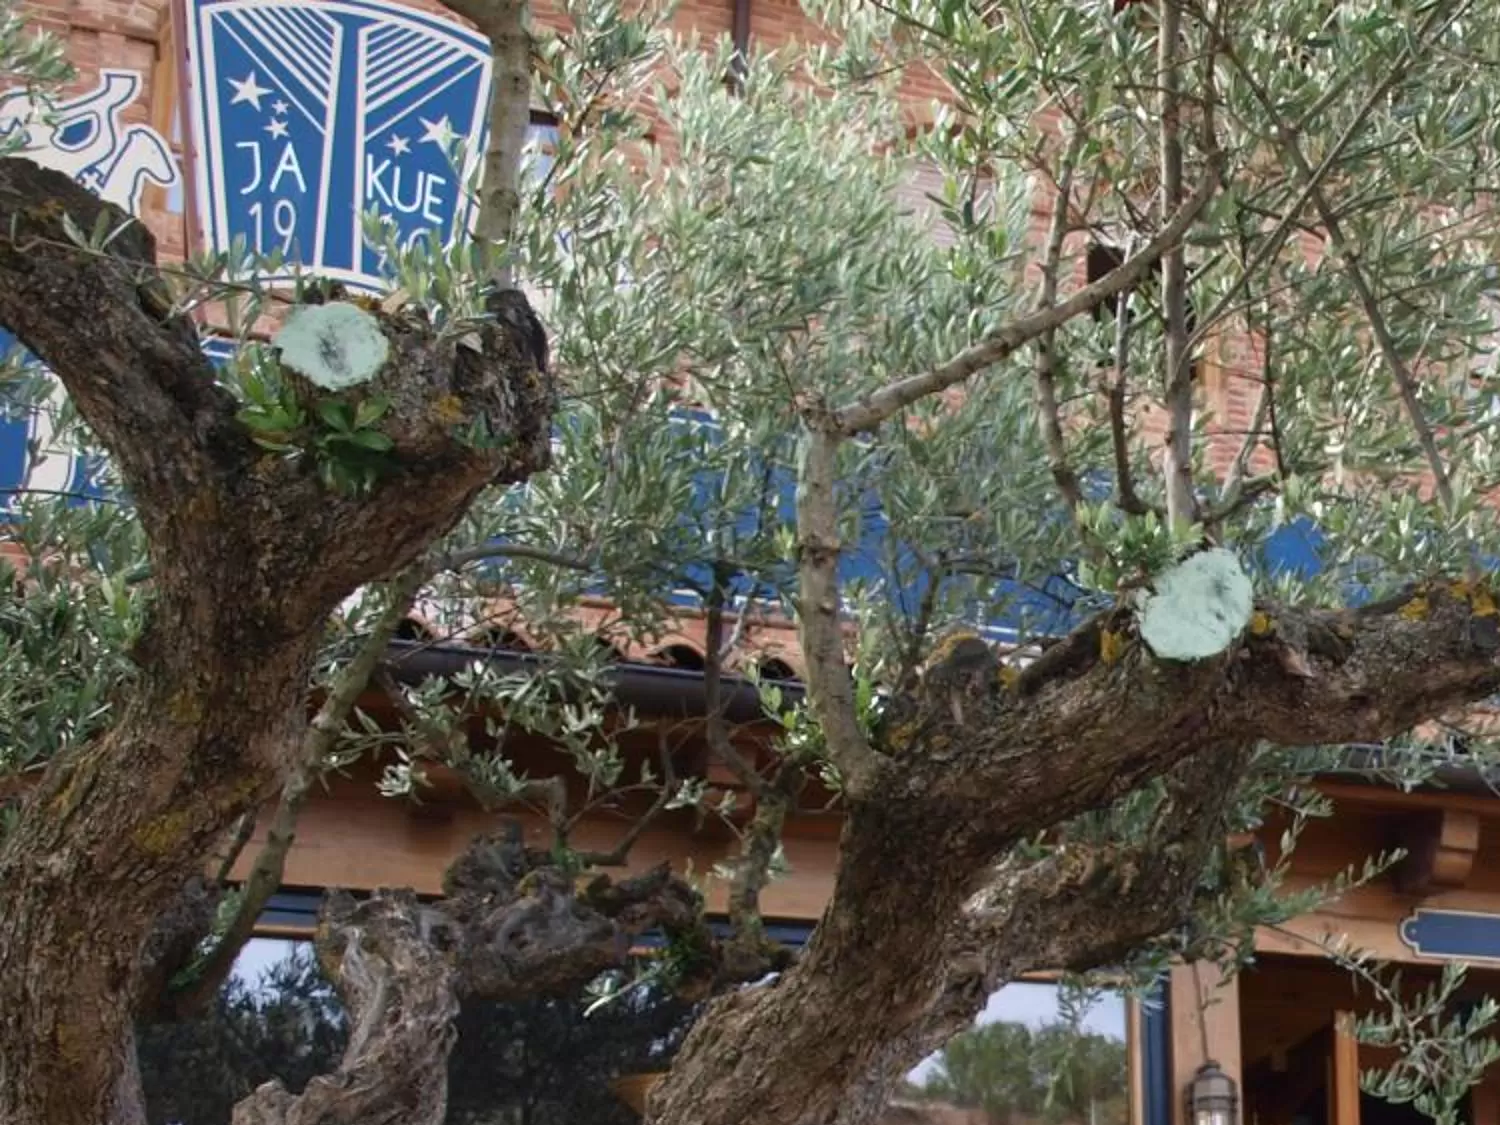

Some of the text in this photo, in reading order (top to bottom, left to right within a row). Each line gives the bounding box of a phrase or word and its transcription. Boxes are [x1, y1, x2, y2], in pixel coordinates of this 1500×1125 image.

[235, 141, 447, 225] JA KUE
[248, 199, 297, 257] 19
